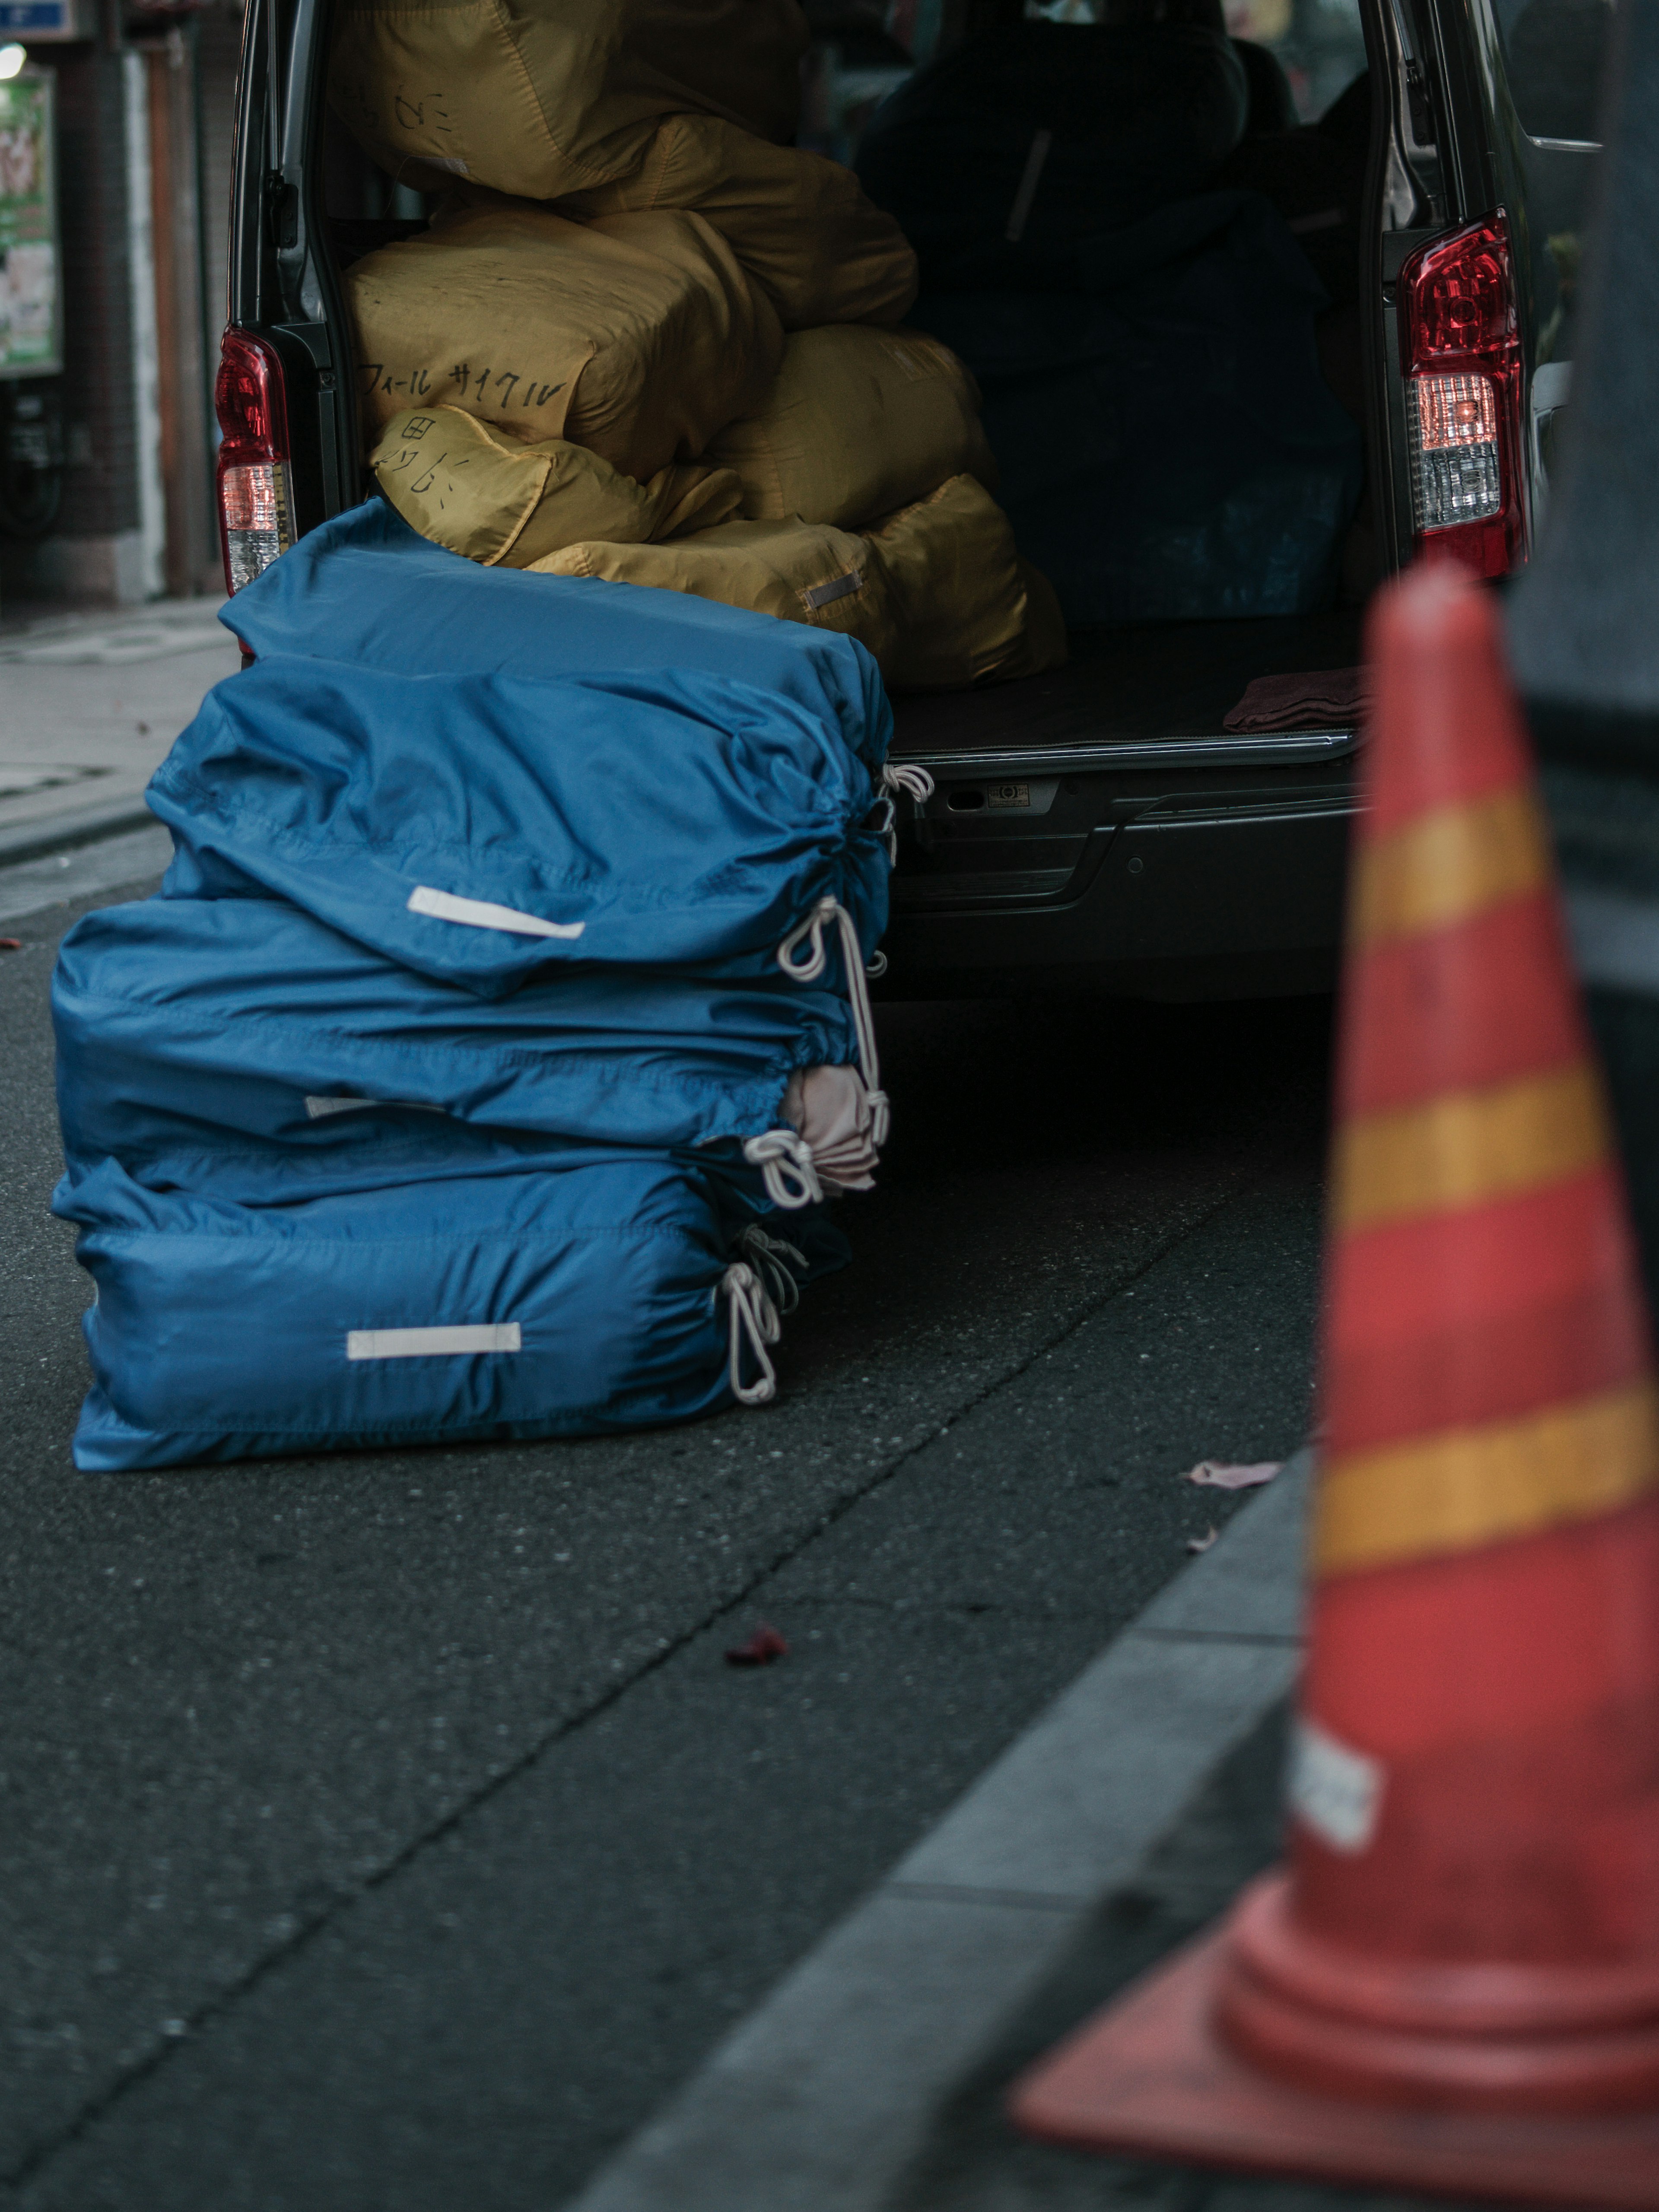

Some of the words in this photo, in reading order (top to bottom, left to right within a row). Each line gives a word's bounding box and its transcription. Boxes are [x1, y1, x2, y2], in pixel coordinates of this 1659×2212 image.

[358, 363, 432, 395] フィール
[448, 363, 567, 409] サイクル
